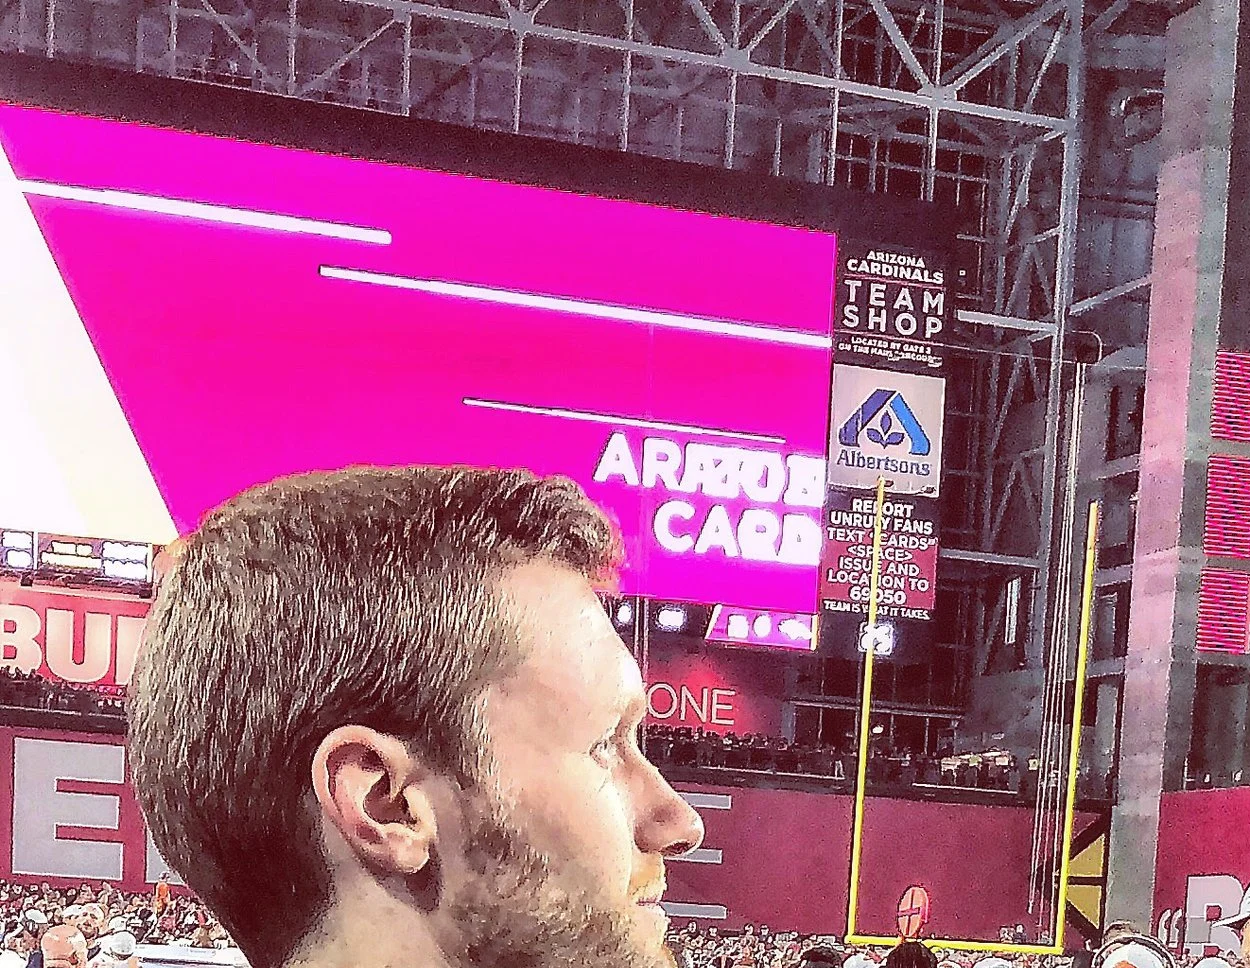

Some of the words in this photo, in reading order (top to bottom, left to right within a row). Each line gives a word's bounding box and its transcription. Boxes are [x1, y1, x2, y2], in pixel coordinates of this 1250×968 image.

[867, 250, 925, 268] ARIZONA
[846, 259, 944, 284] CARDINALS
[844, 279, 945, 316] TEAM
[842, 304, 943, 339] SHOP
[836, 449, 931, 477] Albertsons
[827, 526, 866, 542] TEXT
[893, 517, 934, 535] FANS
[886, 562, 920, 577] AND
[908, 577, 930, 592] TO
[823, 600, 850, 613] TEAM
[862, 604, 888, 617] WAT
[0, 603, 148, 686] BU
[646, 682, 736, 726] ONE
